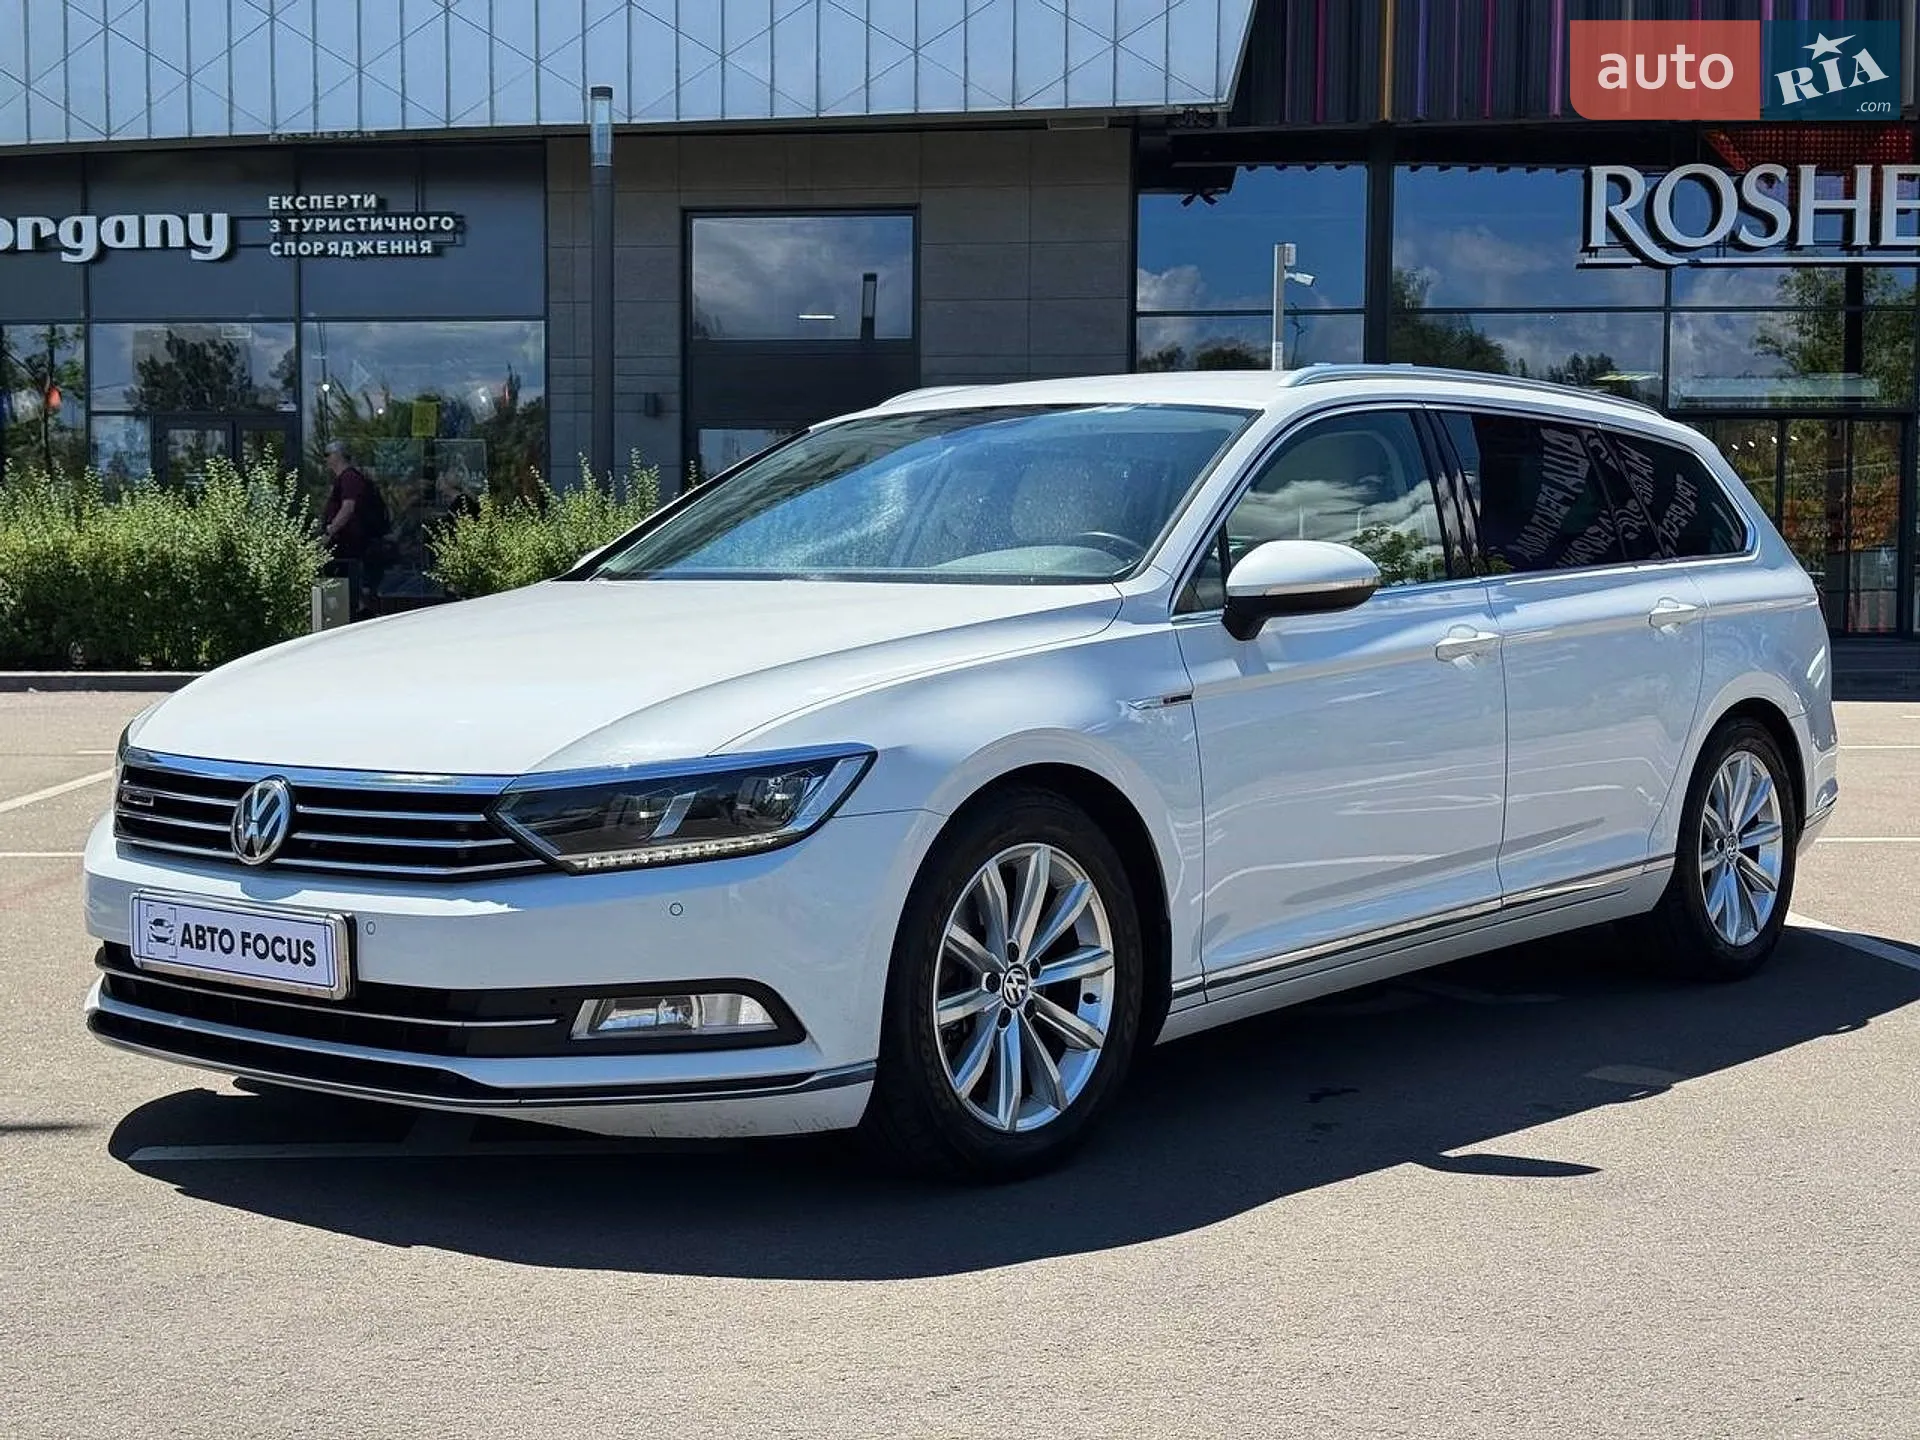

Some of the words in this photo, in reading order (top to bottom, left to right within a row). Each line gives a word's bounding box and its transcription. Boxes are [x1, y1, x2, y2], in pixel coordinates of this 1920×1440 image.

[268, 194, 377, 210] ЕКСПЕРТИ
[1588, 163, 1920, 265] ROSHE
[288, 216, 455, 233] ТУРИСТИЧНОГО
[270, 240, 433, 258] СПОРЯДЖЕННЯ
[180, 922, 235, 955] АВТО
[241, 931, 317, 967] FOCUS
